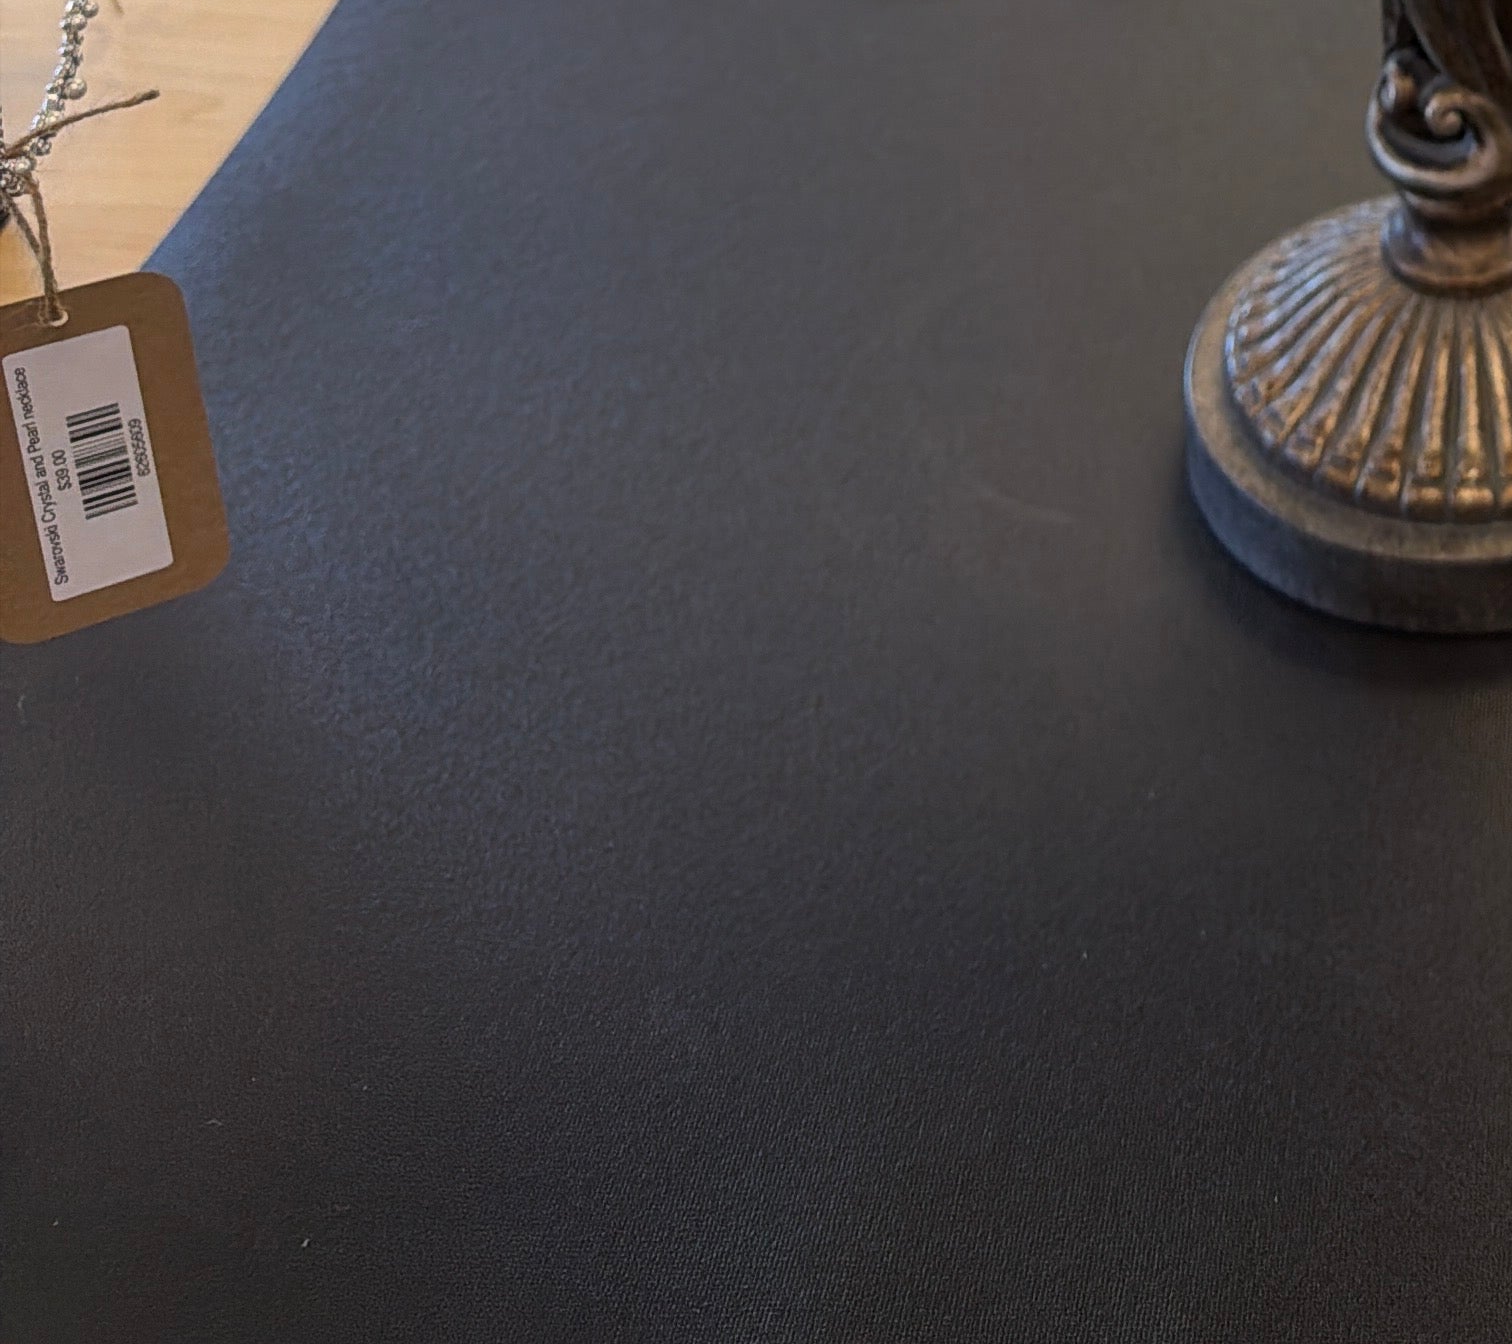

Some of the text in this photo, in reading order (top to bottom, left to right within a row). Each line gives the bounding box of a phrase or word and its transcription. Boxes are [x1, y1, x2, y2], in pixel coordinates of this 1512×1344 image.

[14, 367, 69, 586] Swarovski Crystal and Pearl necklace
[51, 449, 72, 491] $39.00
